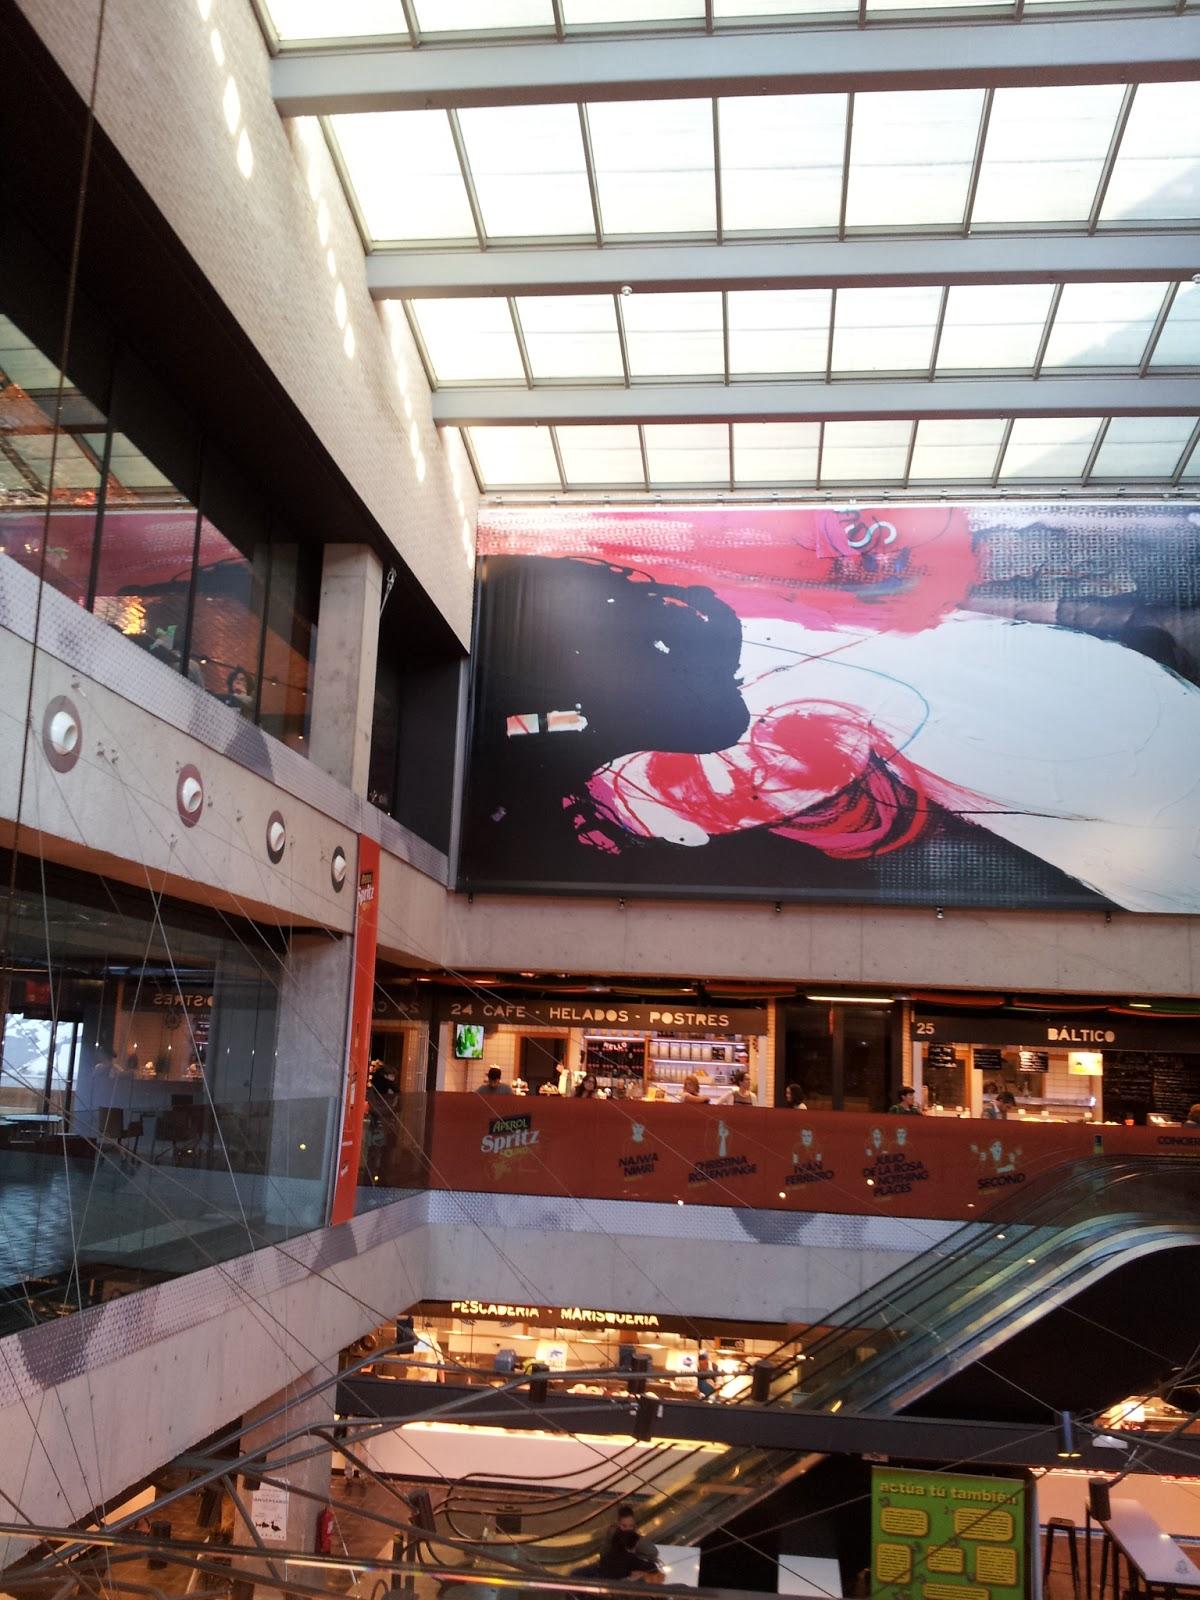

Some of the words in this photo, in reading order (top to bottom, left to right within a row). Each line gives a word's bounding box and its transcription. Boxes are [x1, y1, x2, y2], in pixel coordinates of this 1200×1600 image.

[450, 1003, 473, 1016] 24
[549, 1007, 629, 1023] HELADOS
[649, 1011, 730, 1027] POSTRES
[916, 1022, 935, 1035] 25
[1047, 1025, 1115, 1043] BÁLTICO
[492, 1118, 528, 1133] APEROL
[480, 1129, 540, 1154] Spritz
[977, 1172, 1025, 1189] SECOND
